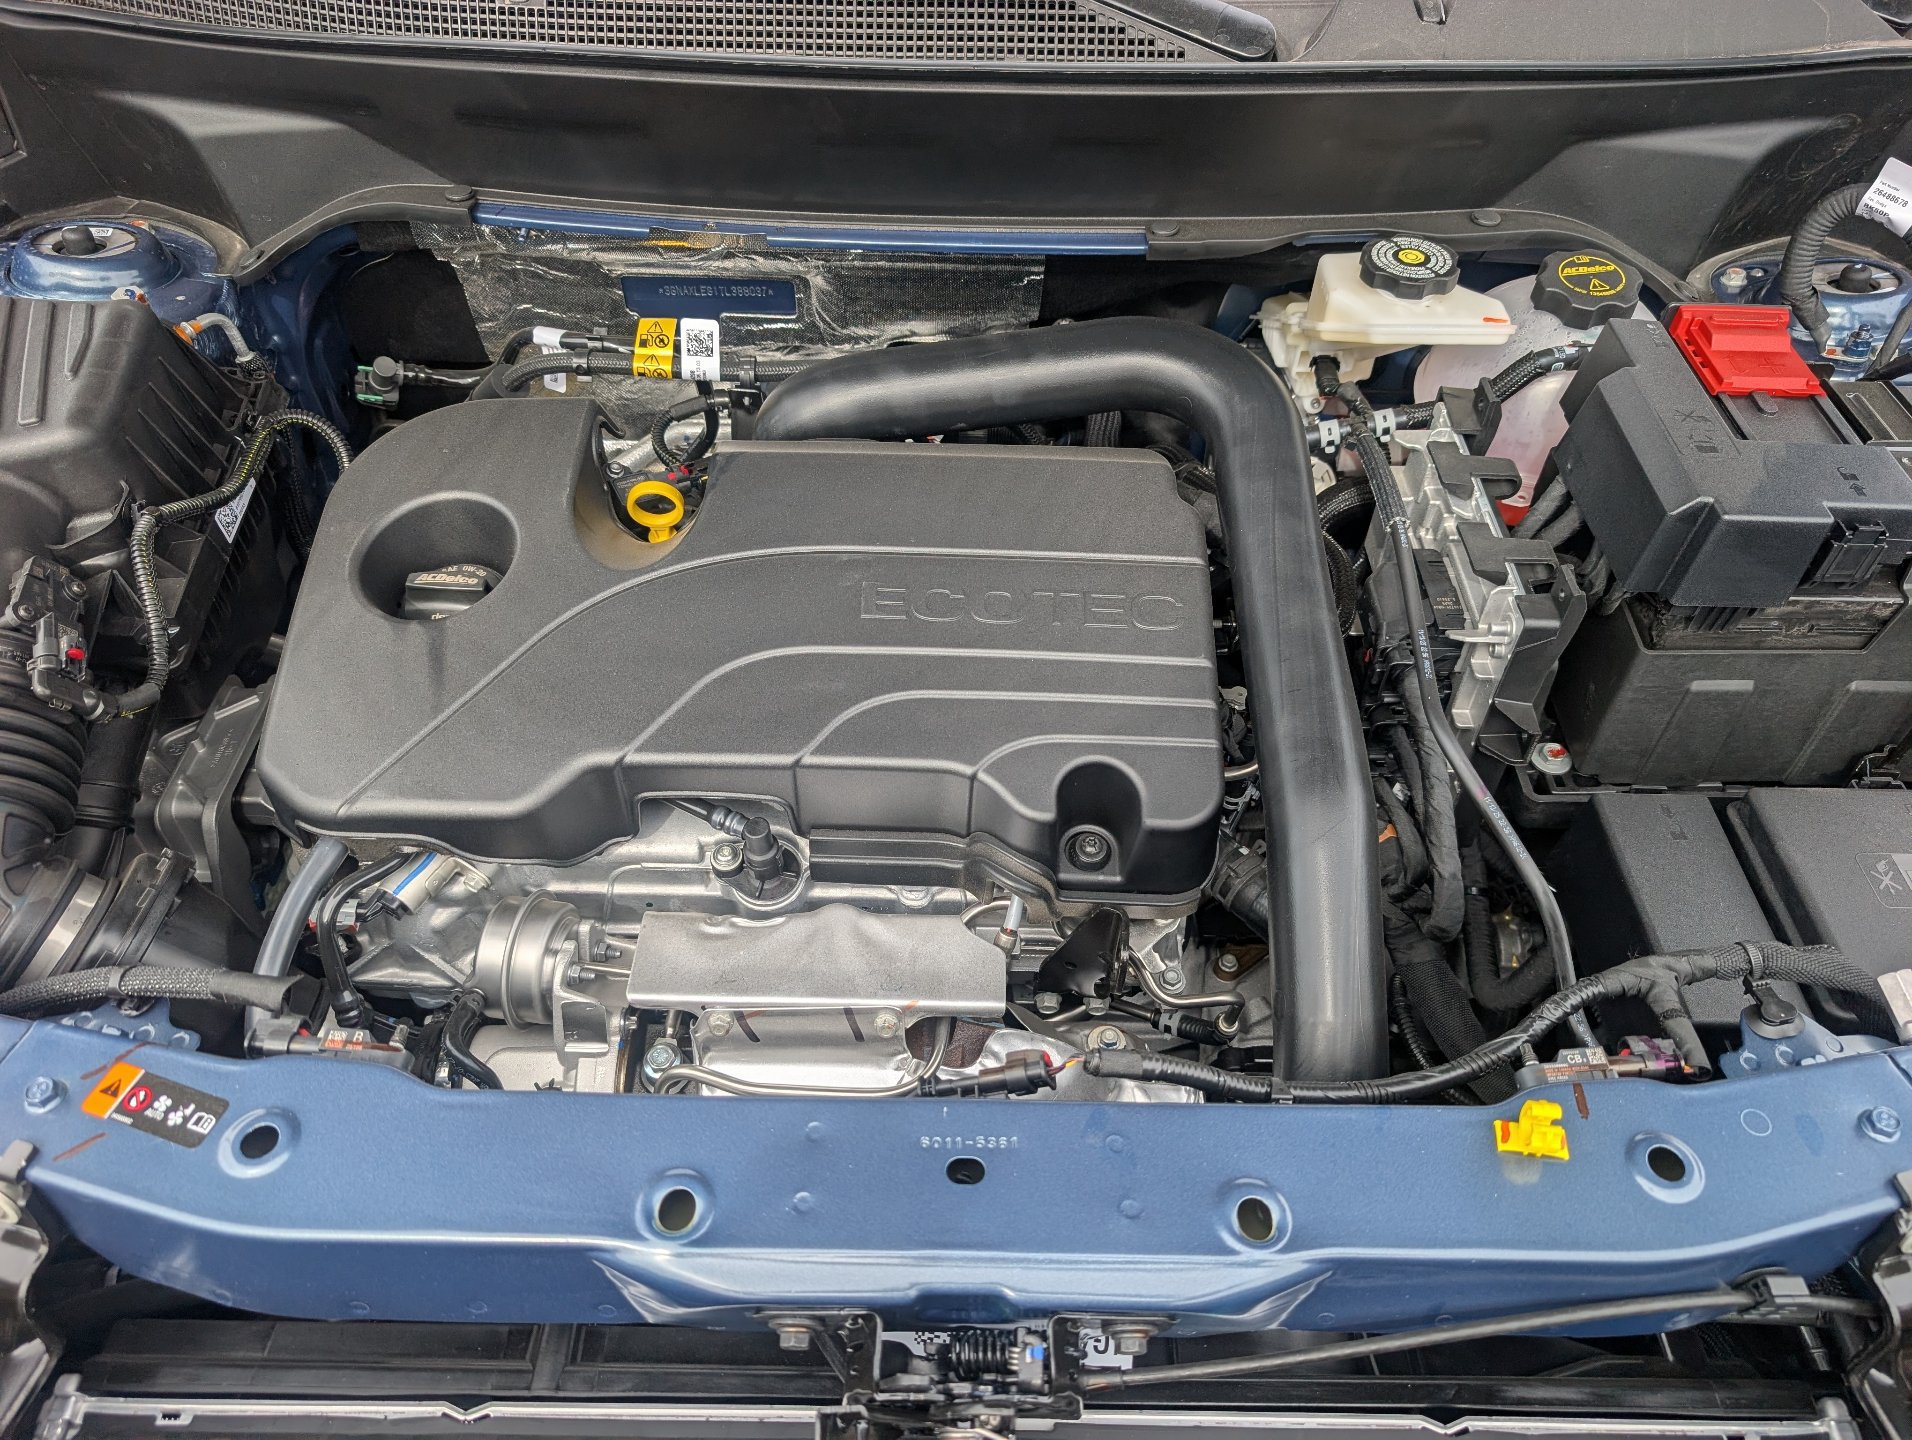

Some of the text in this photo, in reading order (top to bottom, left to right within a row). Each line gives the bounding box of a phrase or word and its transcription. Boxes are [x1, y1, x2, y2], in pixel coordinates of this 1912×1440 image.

[1562, 265, 1615, 276] ACDelco
[462, 565, 487, 577] 0W-20
[413, 573, 479, 585] ACDelco
[860, 580, 1185, 631] ECOTEC
[352, 1030, 364, 1043] B
